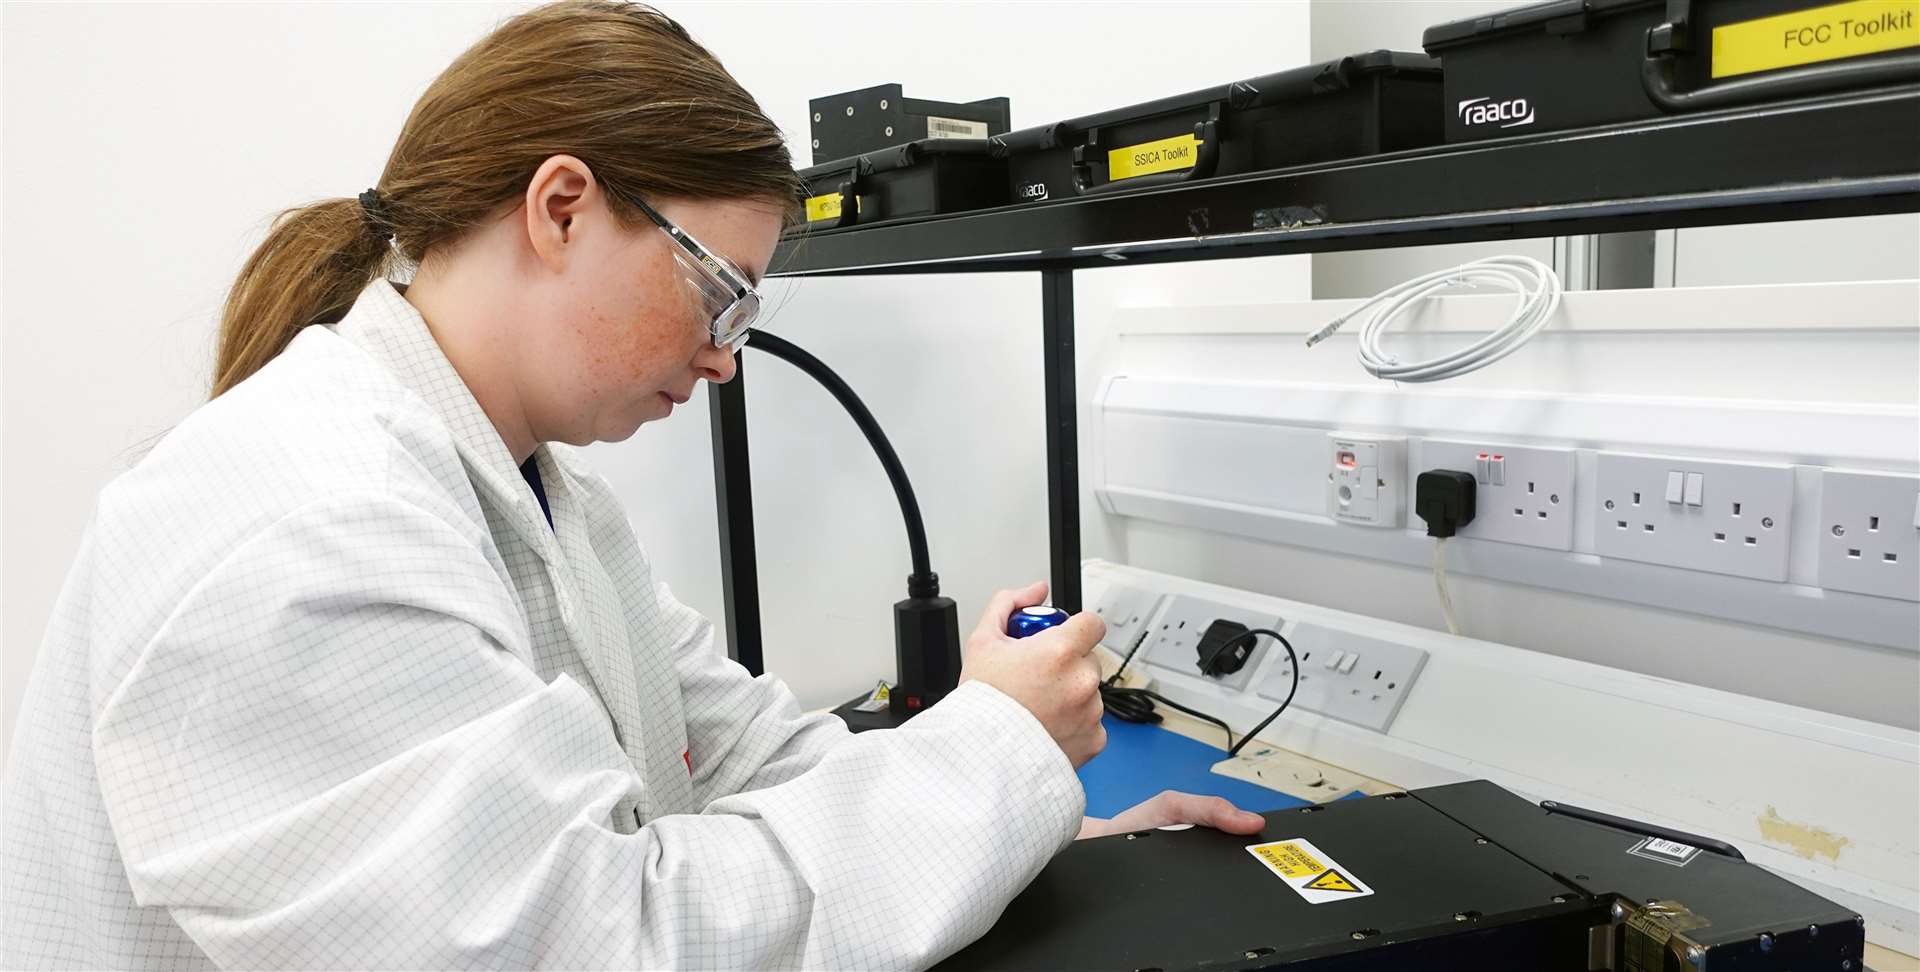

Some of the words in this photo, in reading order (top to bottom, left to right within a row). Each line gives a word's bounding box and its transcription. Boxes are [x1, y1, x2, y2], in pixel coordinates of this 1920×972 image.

[1783, 23, 1832, 49] FCC
[1838, 10, 1912, 40] Toolkit
[1464, 98, 1528, 126] raaco
[1133, 150, 1161, 167] SSICA
[1162, 145, 1189, 162] Toolkit
